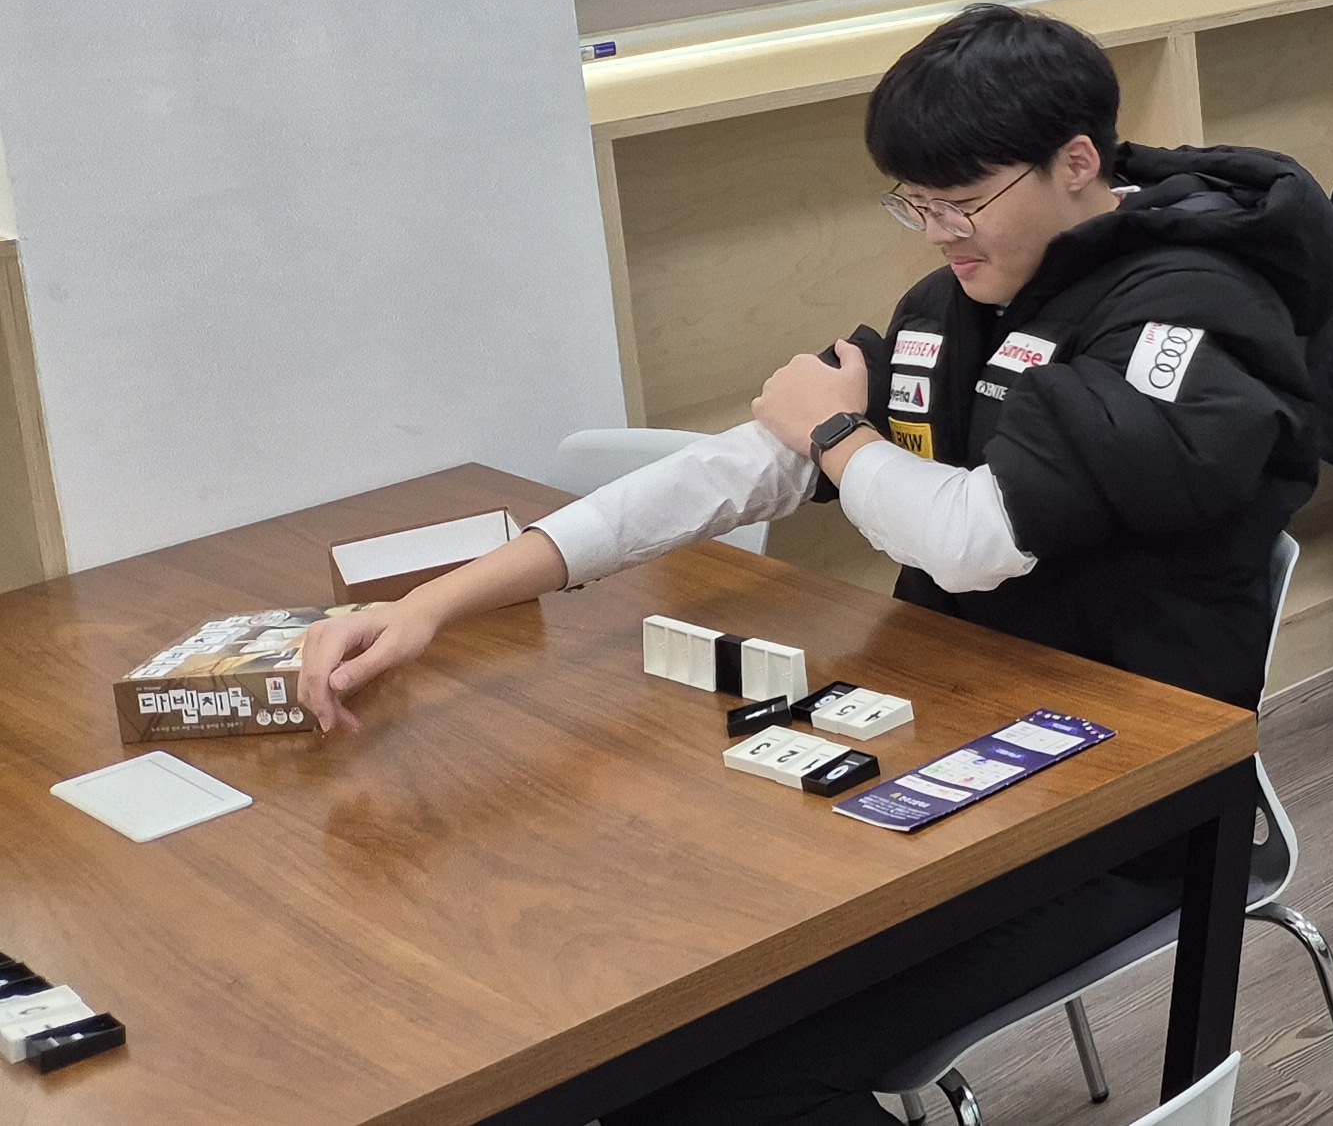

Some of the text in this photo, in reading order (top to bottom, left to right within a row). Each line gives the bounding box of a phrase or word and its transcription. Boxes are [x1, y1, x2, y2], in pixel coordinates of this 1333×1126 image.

[836, 705, 857, 716] 5
[749, 742, 772, 756] 3
[777, 750, 800, 764] 2
